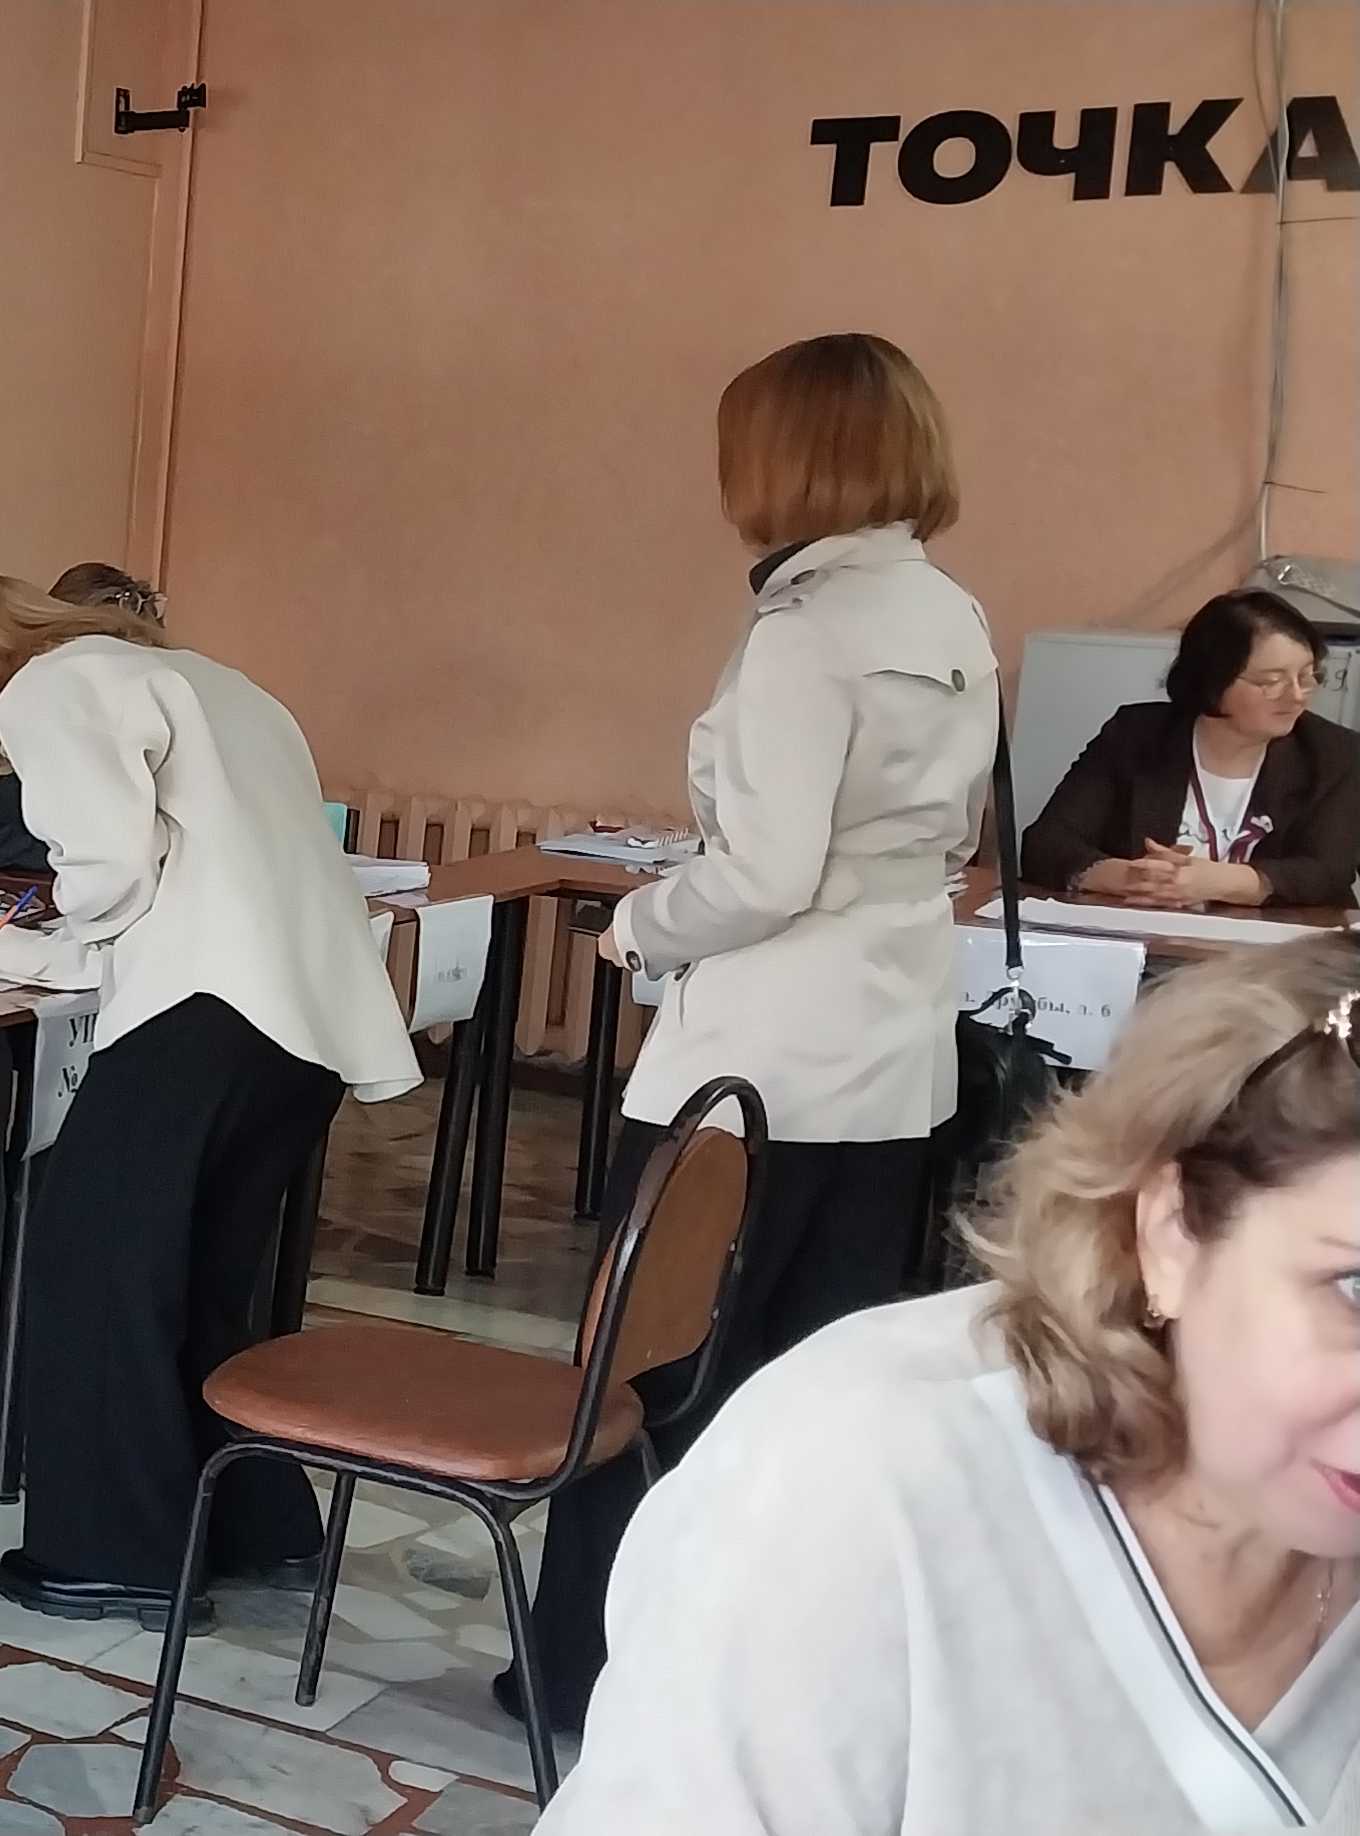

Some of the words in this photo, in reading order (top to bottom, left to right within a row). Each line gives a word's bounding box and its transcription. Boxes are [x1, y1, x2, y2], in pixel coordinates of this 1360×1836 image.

[809, 95, 1360, 207] ТОЧКА
[1100, 1003, 1111, 1018] 6
[68, 1013, 98, 1047] УИ
